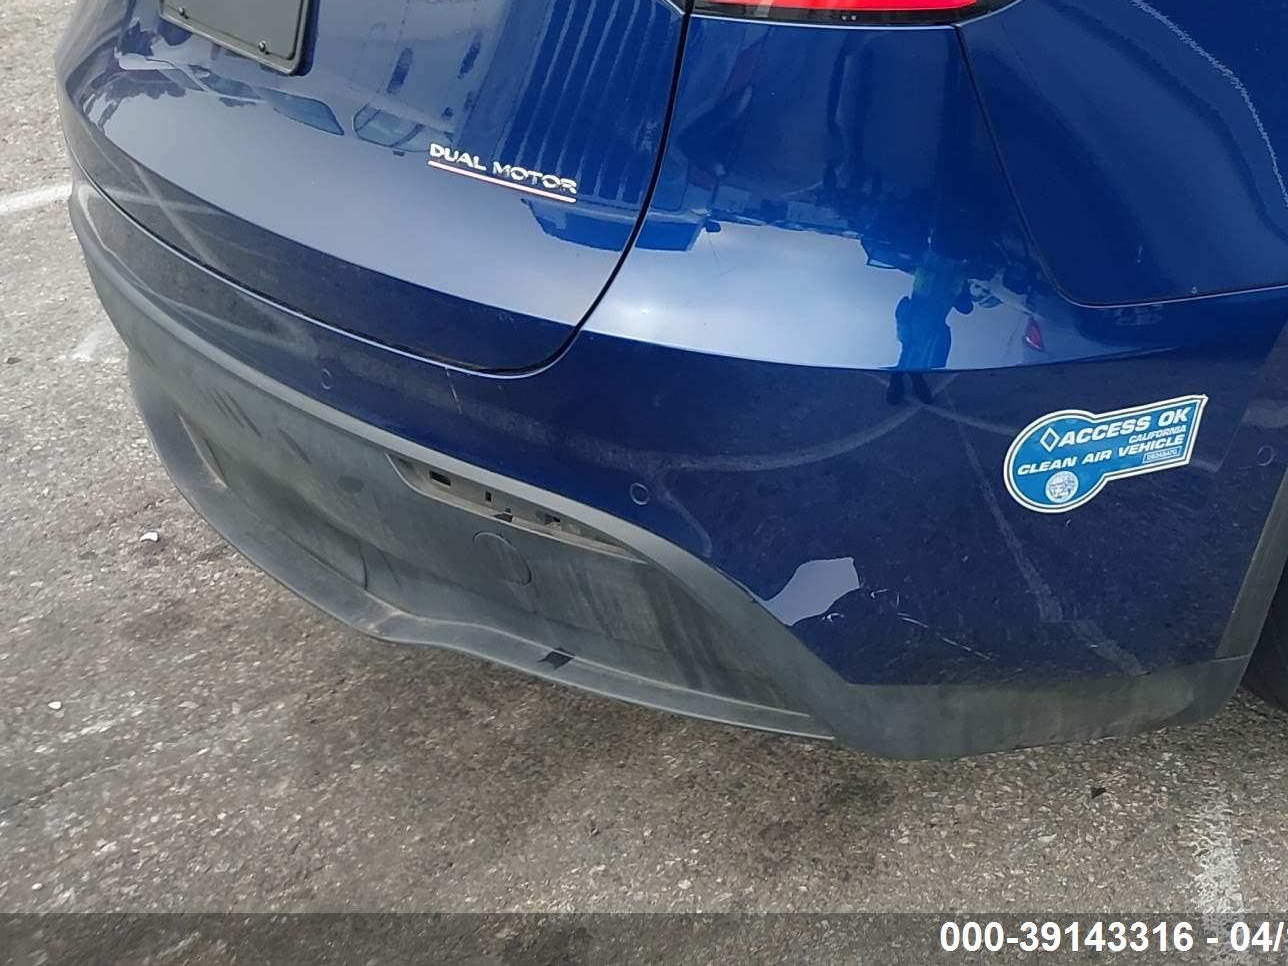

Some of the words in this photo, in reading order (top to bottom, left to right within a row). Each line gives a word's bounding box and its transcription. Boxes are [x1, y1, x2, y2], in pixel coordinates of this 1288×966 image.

[429, 143, 487, 171] DUAL
[492, 161, 577, 194] MOTOR
[1058, 415, 1151, 447] ACCESS
[1158, 407, 1192, 428] OK
[1129, 425, 1187, 444] CALIFORNIA
[1017, 456, 1078, 475] CLEAN
[1081, 449, 1113, 465] AIR
[1118, 434, 1185, 457] VEHICLE
